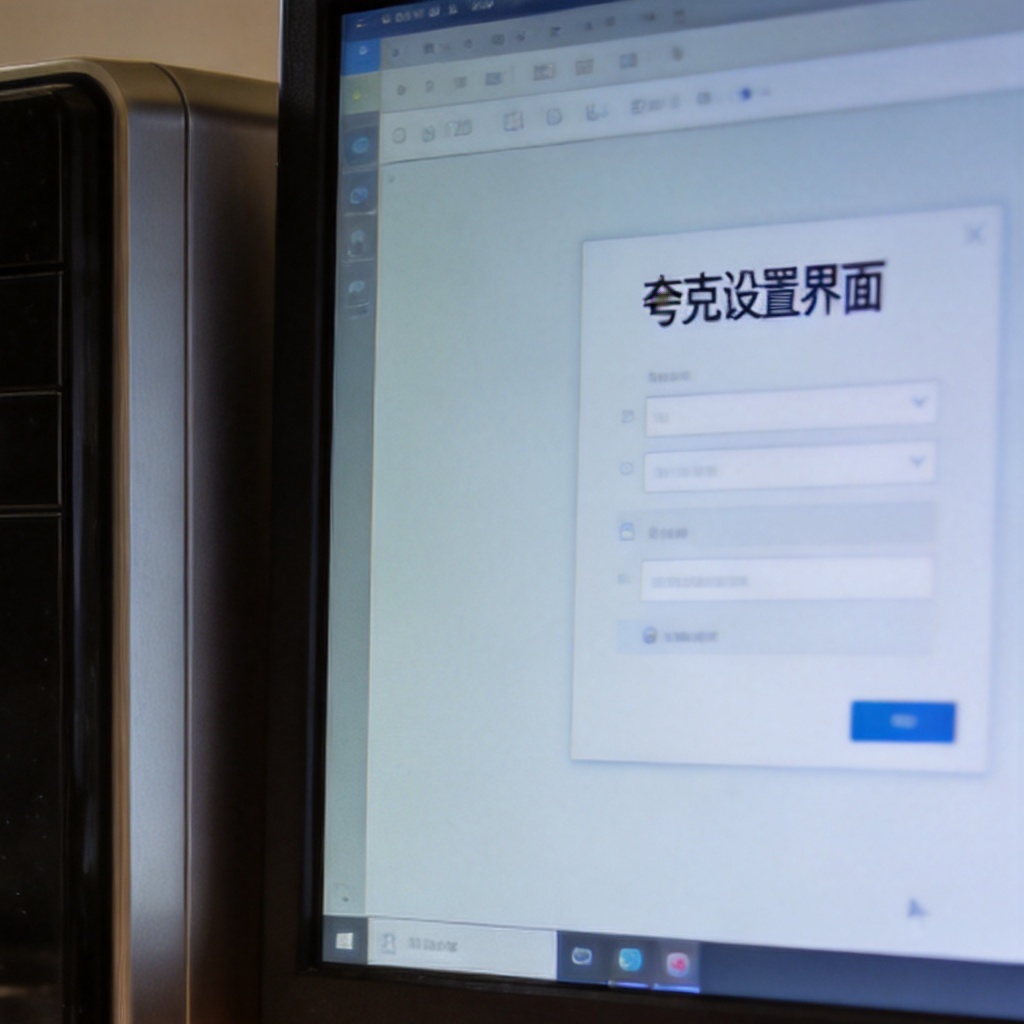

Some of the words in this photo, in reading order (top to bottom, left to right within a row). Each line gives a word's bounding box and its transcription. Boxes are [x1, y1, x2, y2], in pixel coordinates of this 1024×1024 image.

[643, 260, 886, 327] 夸克设置界面
